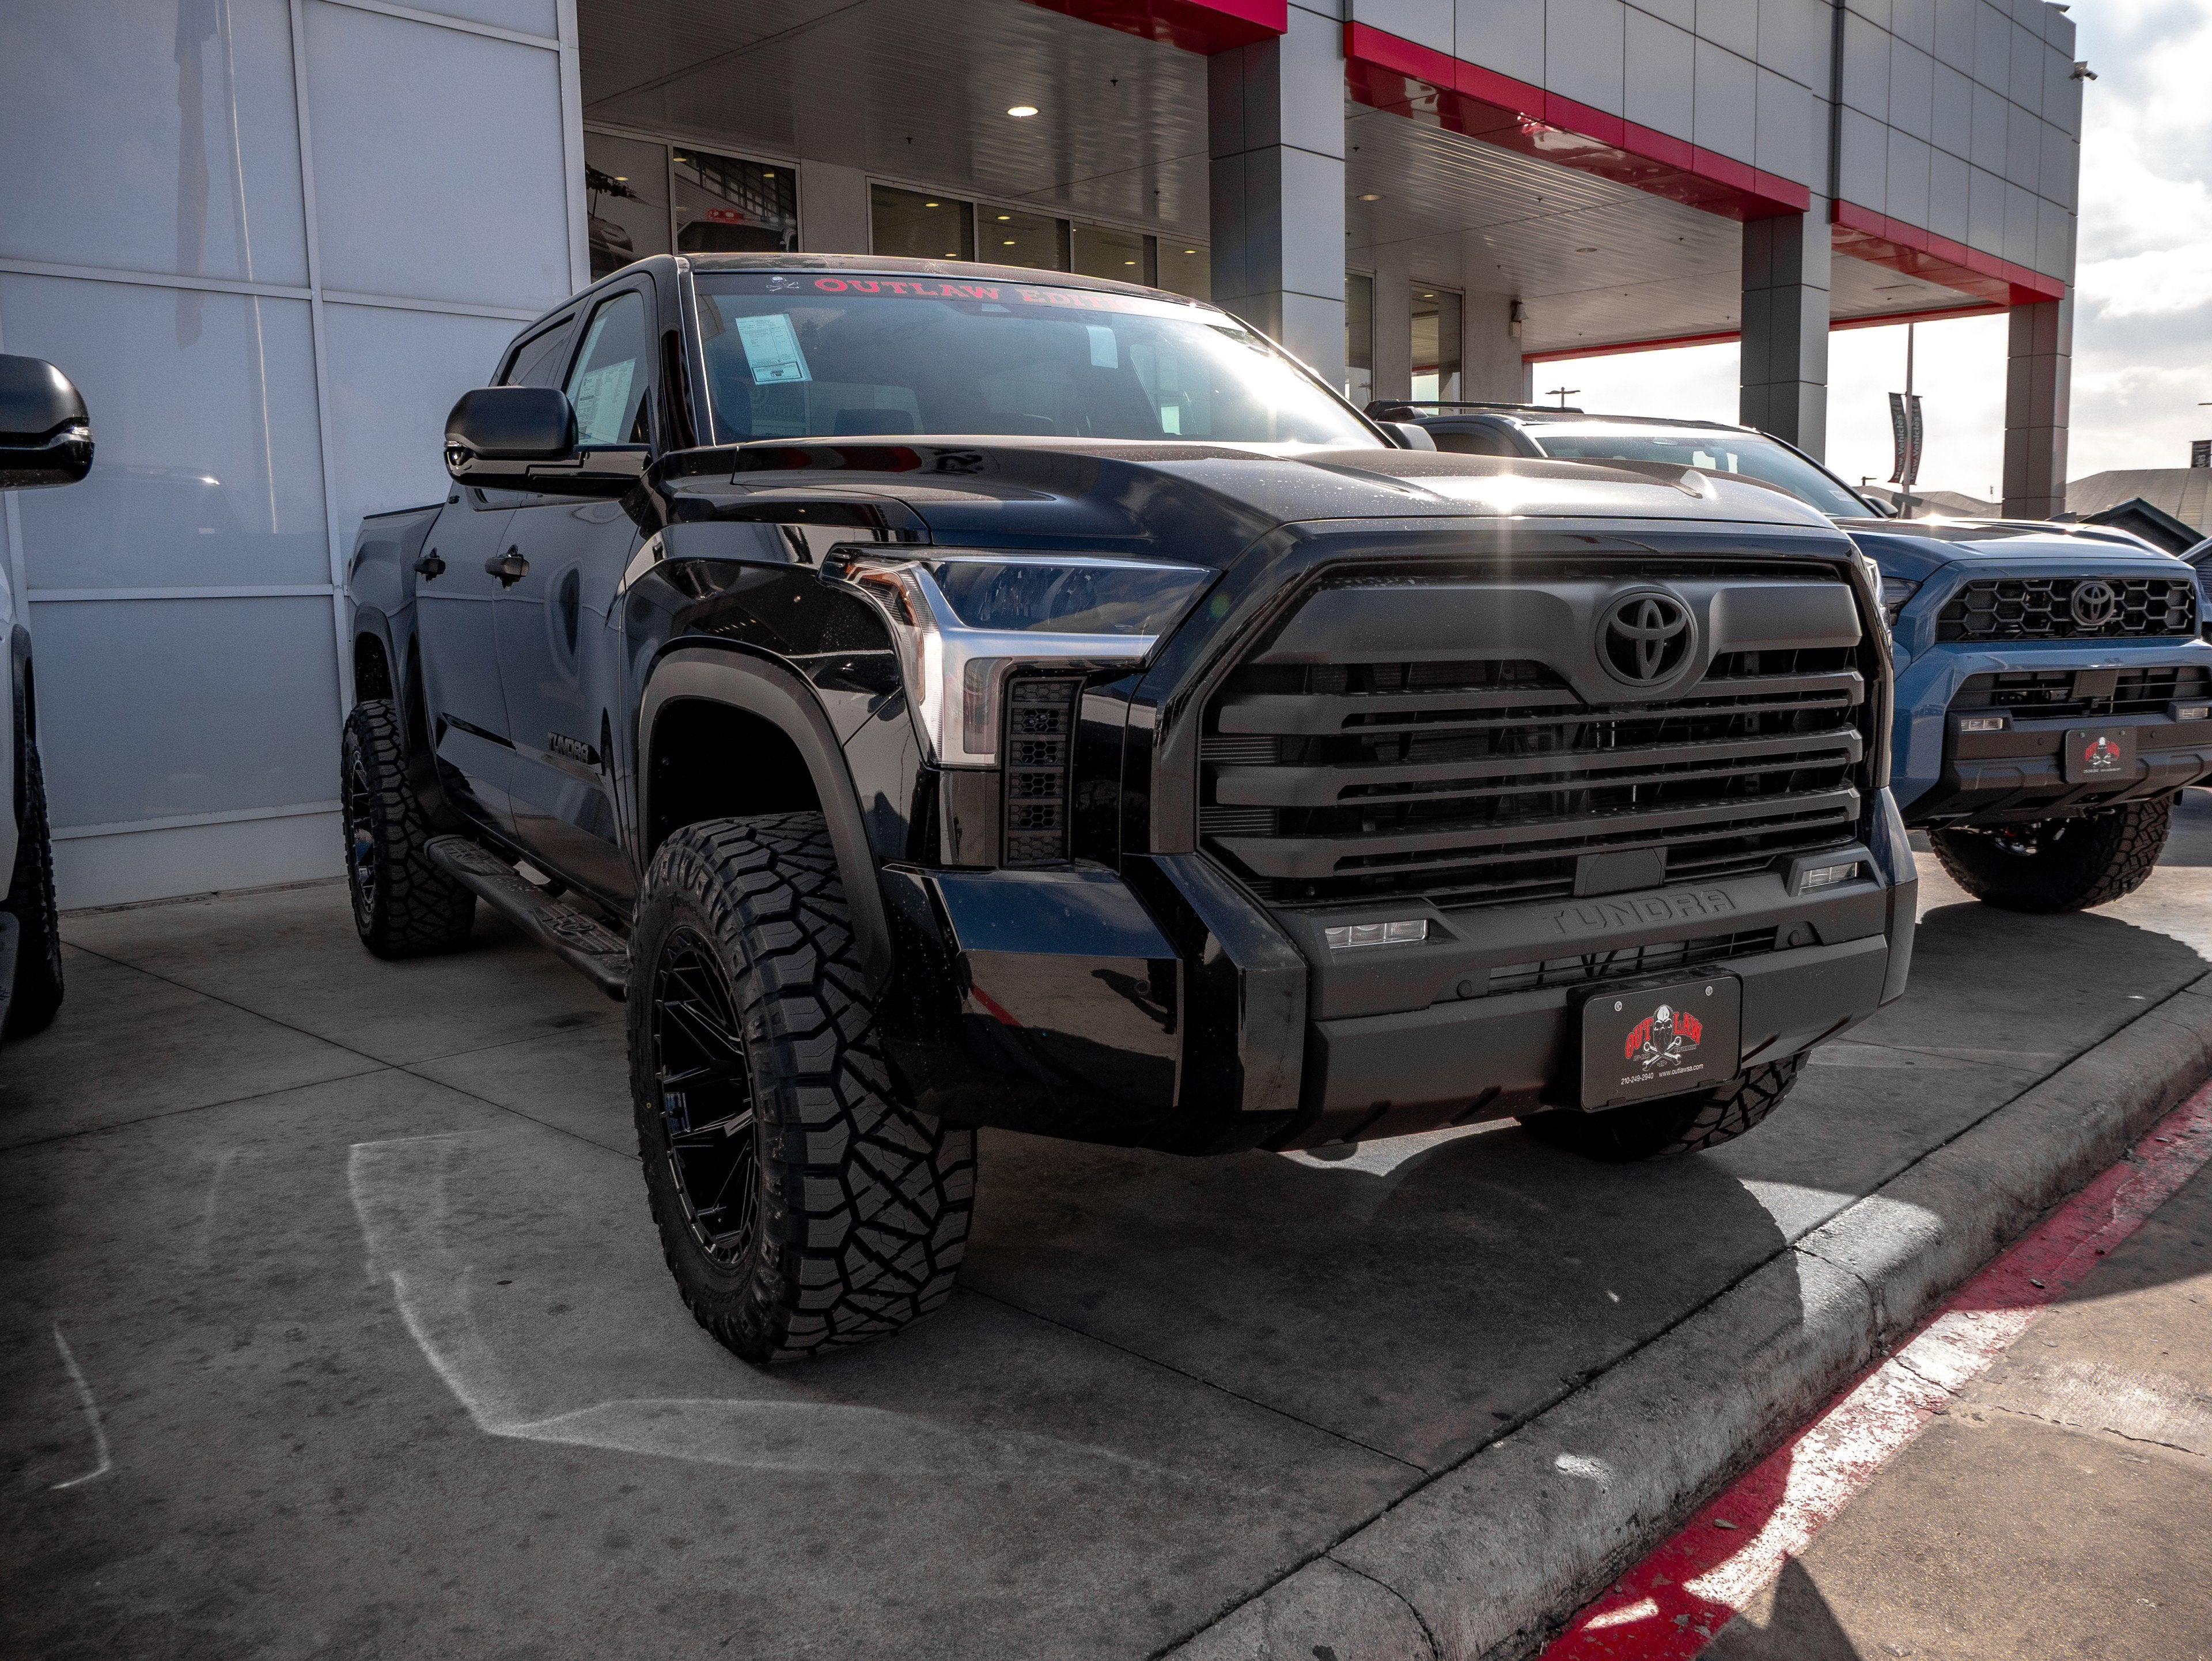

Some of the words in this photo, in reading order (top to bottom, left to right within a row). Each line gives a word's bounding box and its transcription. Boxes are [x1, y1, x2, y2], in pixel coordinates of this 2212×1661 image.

[815, 278, 1001, 299] OUTLAW
[1015, 288, 1144, 312] EDITIO
[1896, 414, 1904, 455] Vehicles
[1894, 458, 1904, 479] New
[1910, 459, 1919, 480] New
[548, 732, 589, 764] TUNDRA
[1532, 889, 1736, 934] TUNDRA
[1620, 1072, 1654, 1085] 210-249-2940
[1658, 1064, 1703, 1077] www.outlawsa.com
